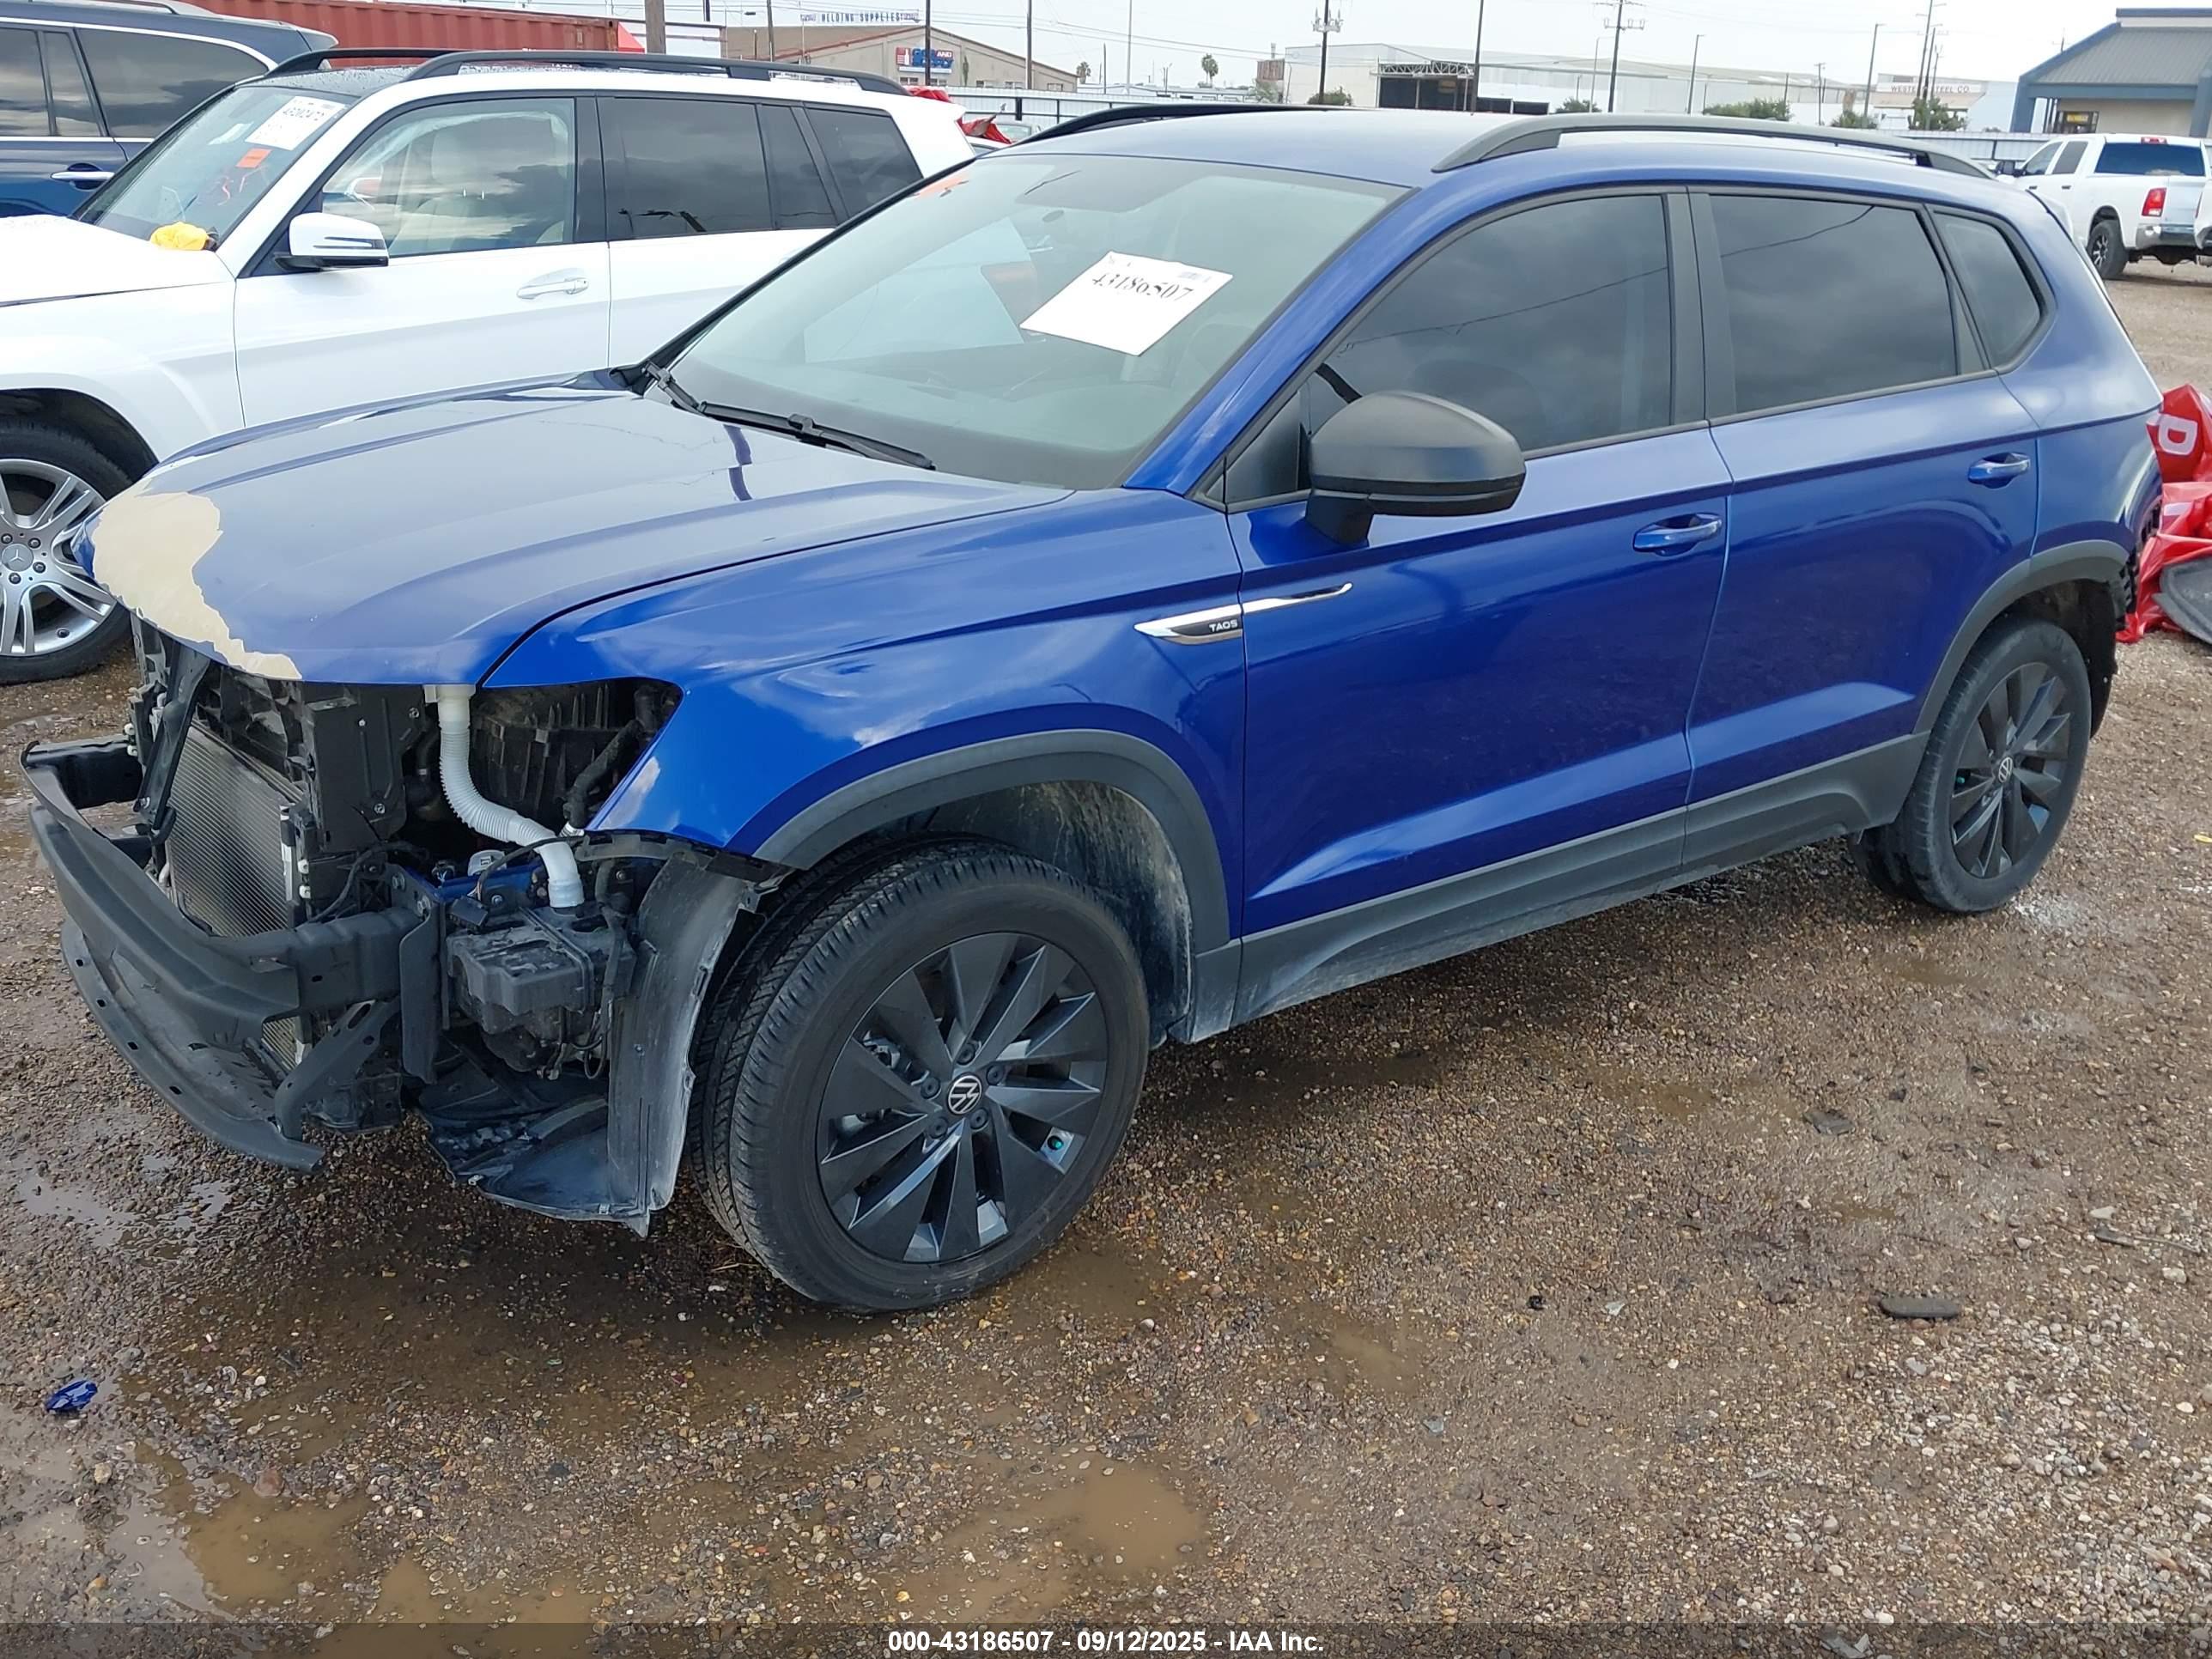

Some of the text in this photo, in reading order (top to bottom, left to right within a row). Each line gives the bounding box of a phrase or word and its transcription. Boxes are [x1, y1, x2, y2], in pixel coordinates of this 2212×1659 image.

[860, 12, 900, 21] SUPPLIES
[1092, 273, 1194, 301] 43186507
[1209, 619, 1238, 633] TAOS
